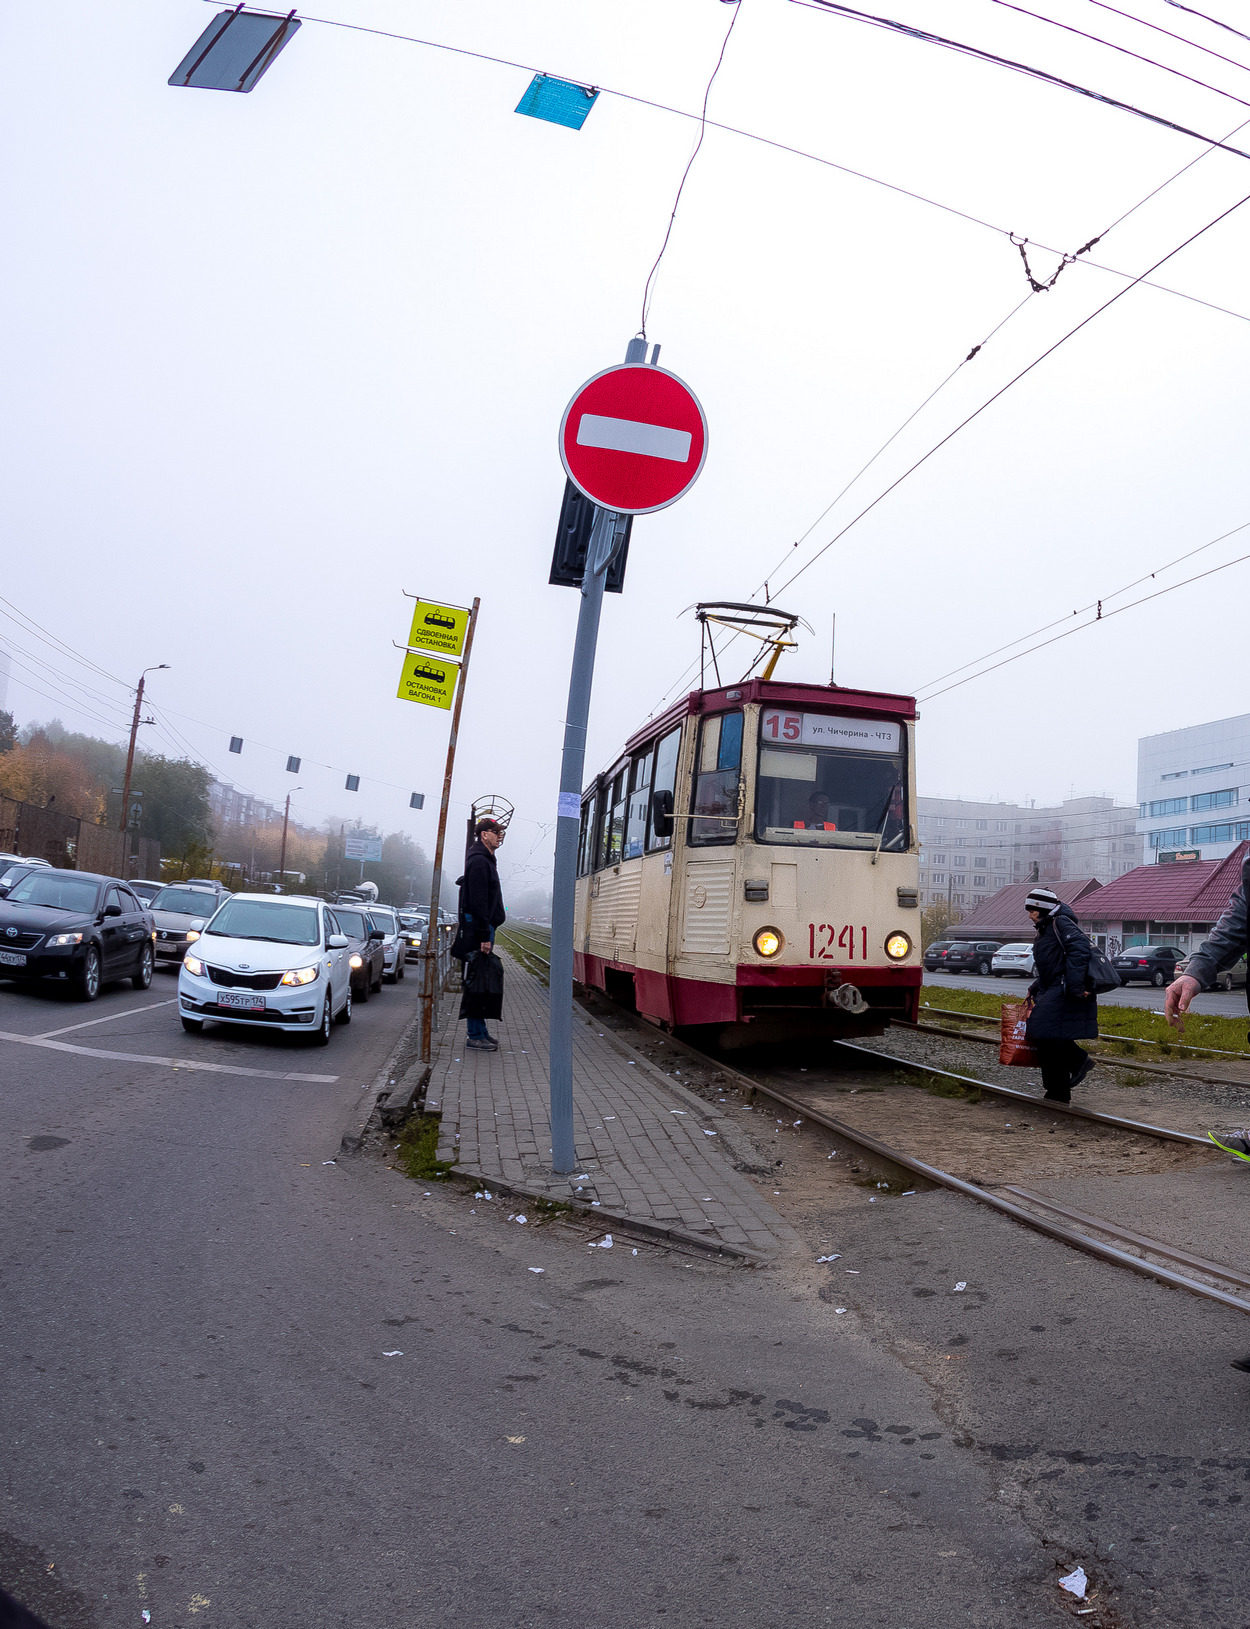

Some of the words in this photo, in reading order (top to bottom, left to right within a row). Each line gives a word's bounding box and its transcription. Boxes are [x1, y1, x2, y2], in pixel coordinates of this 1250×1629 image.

[416, 628, 458, 642] СДВОЕННАЯ
[415, 636, 456, 650] ОСТАНОВКА
[406, 680, 447, 696] ОСТАНОВКА
[408, 689, 436, 702] ВАГОНА
[766, 715, 800, 740] 15
[812, 726, 825, 735] ул.
[827, 727, 869, 738] Чичерина
[875, 732, 892, 741] ЧТЗ
[808, 923, 867, 960] 1241
